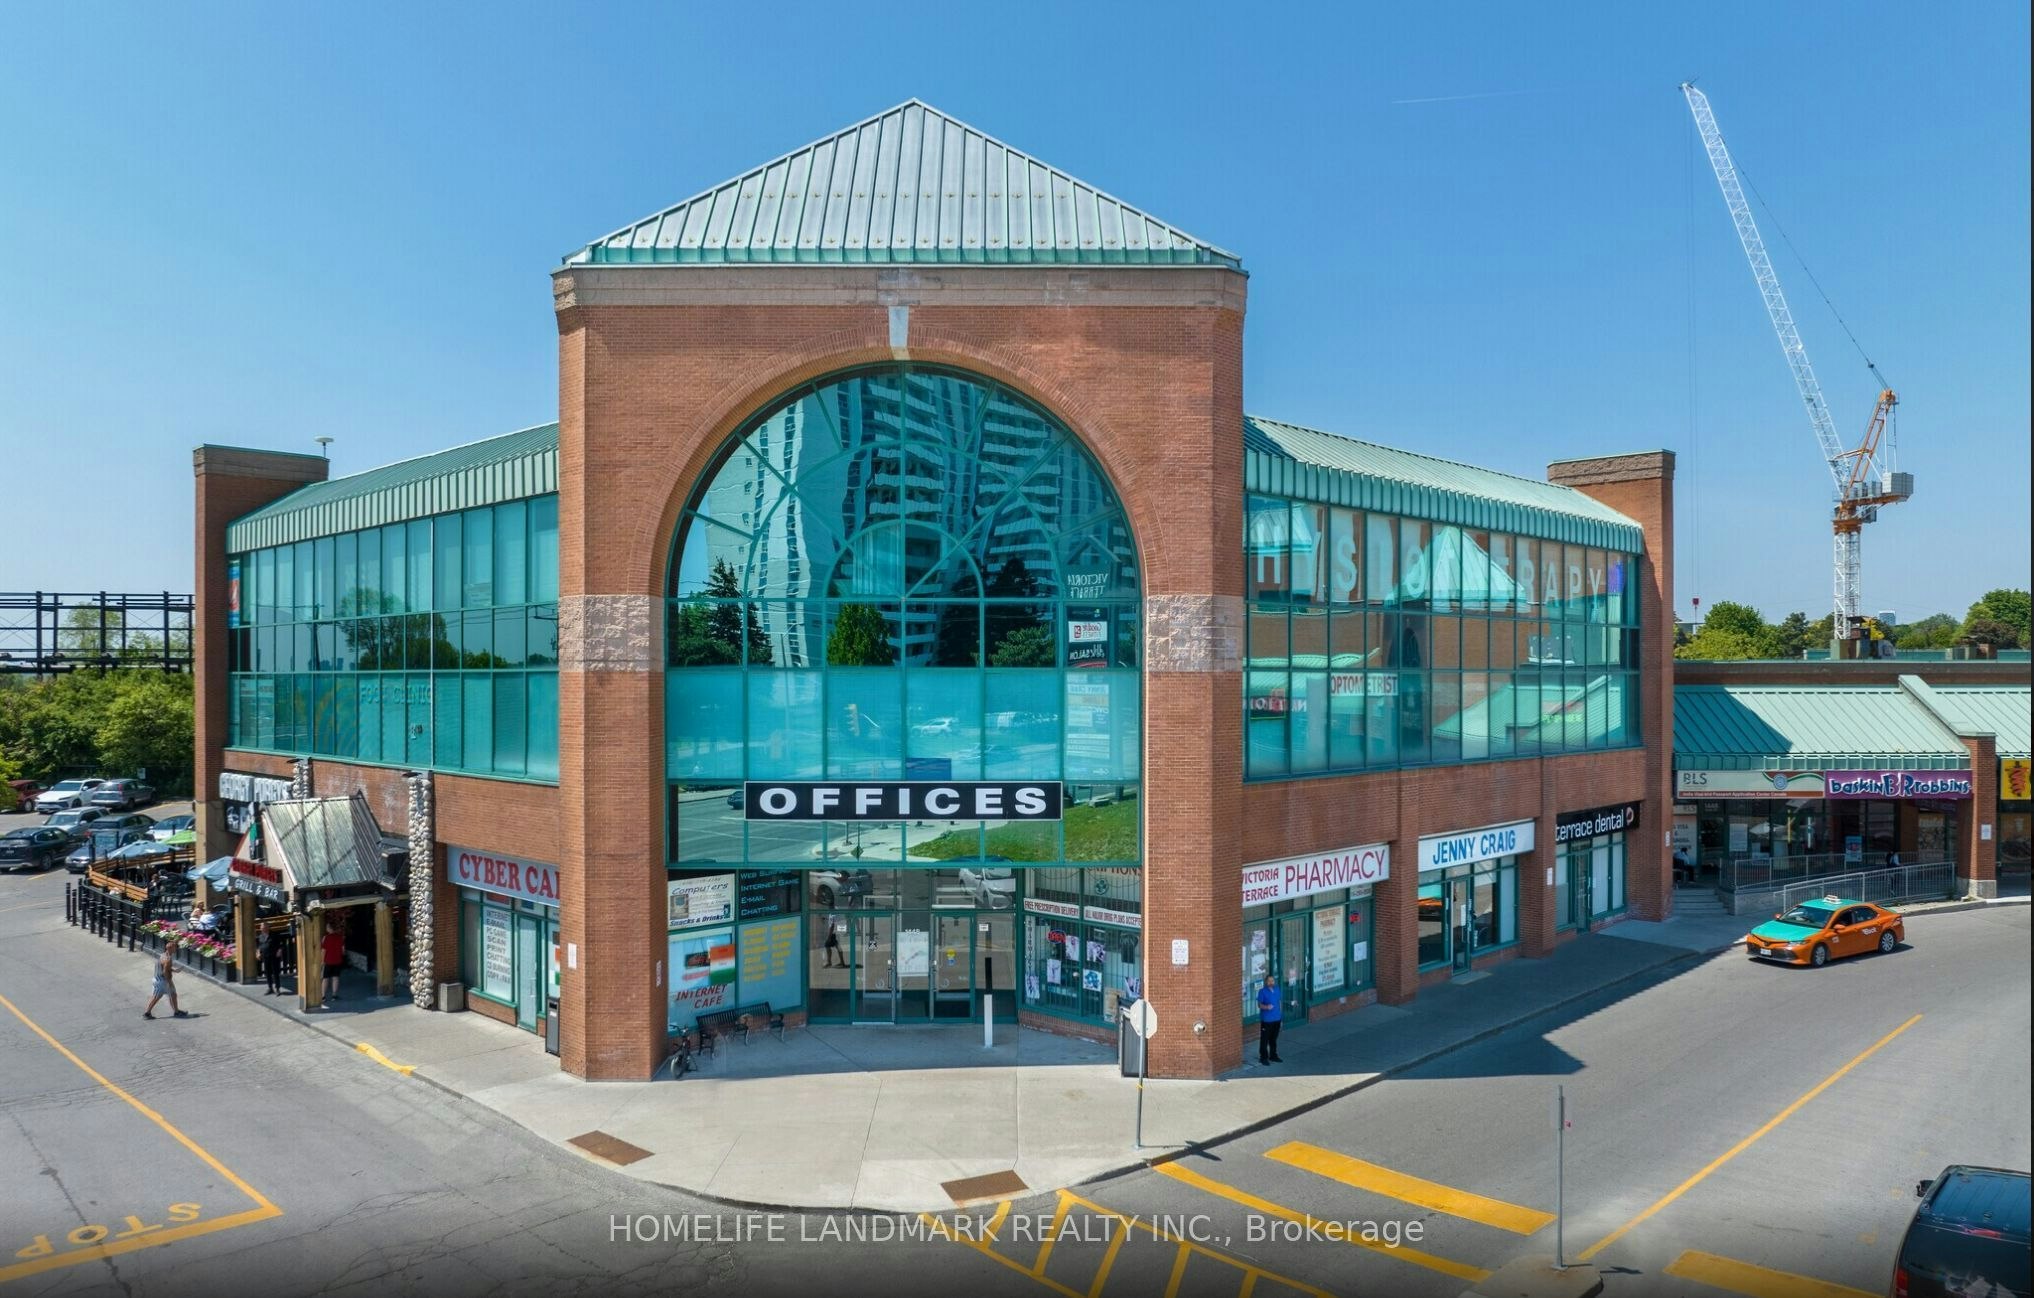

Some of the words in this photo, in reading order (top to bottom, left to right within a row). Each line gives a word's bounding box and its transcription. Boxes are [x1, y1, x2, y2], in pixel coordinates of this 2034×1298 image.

[1683, 772, 1707, 785] BLS
[1829, 777, 1883, 795] baskin
[1914, 778, 1970, 795] robbins
[759, 787, 1047, 815] OFFICES
[1555, 818, 1593, 842] terrace
[1595, 808, 1624, 833] dental
[1433, 837, 1475, 864] JENNY
[1480, 830, 1516, 856] CRAIG
[459, 853, 521, 891] CYBER
[1285, 849, 1385, 894] PHARMACY
[264, 887, 278, 900] BAR
[672, 882, 728, 895] Computers
[670, 918, 695, 926] Snacks
[676, 985, 727, 1001] INTERNET
[694, 996, 722, 1009] CAFE
[15, 1203, 201, 1257] STOP
